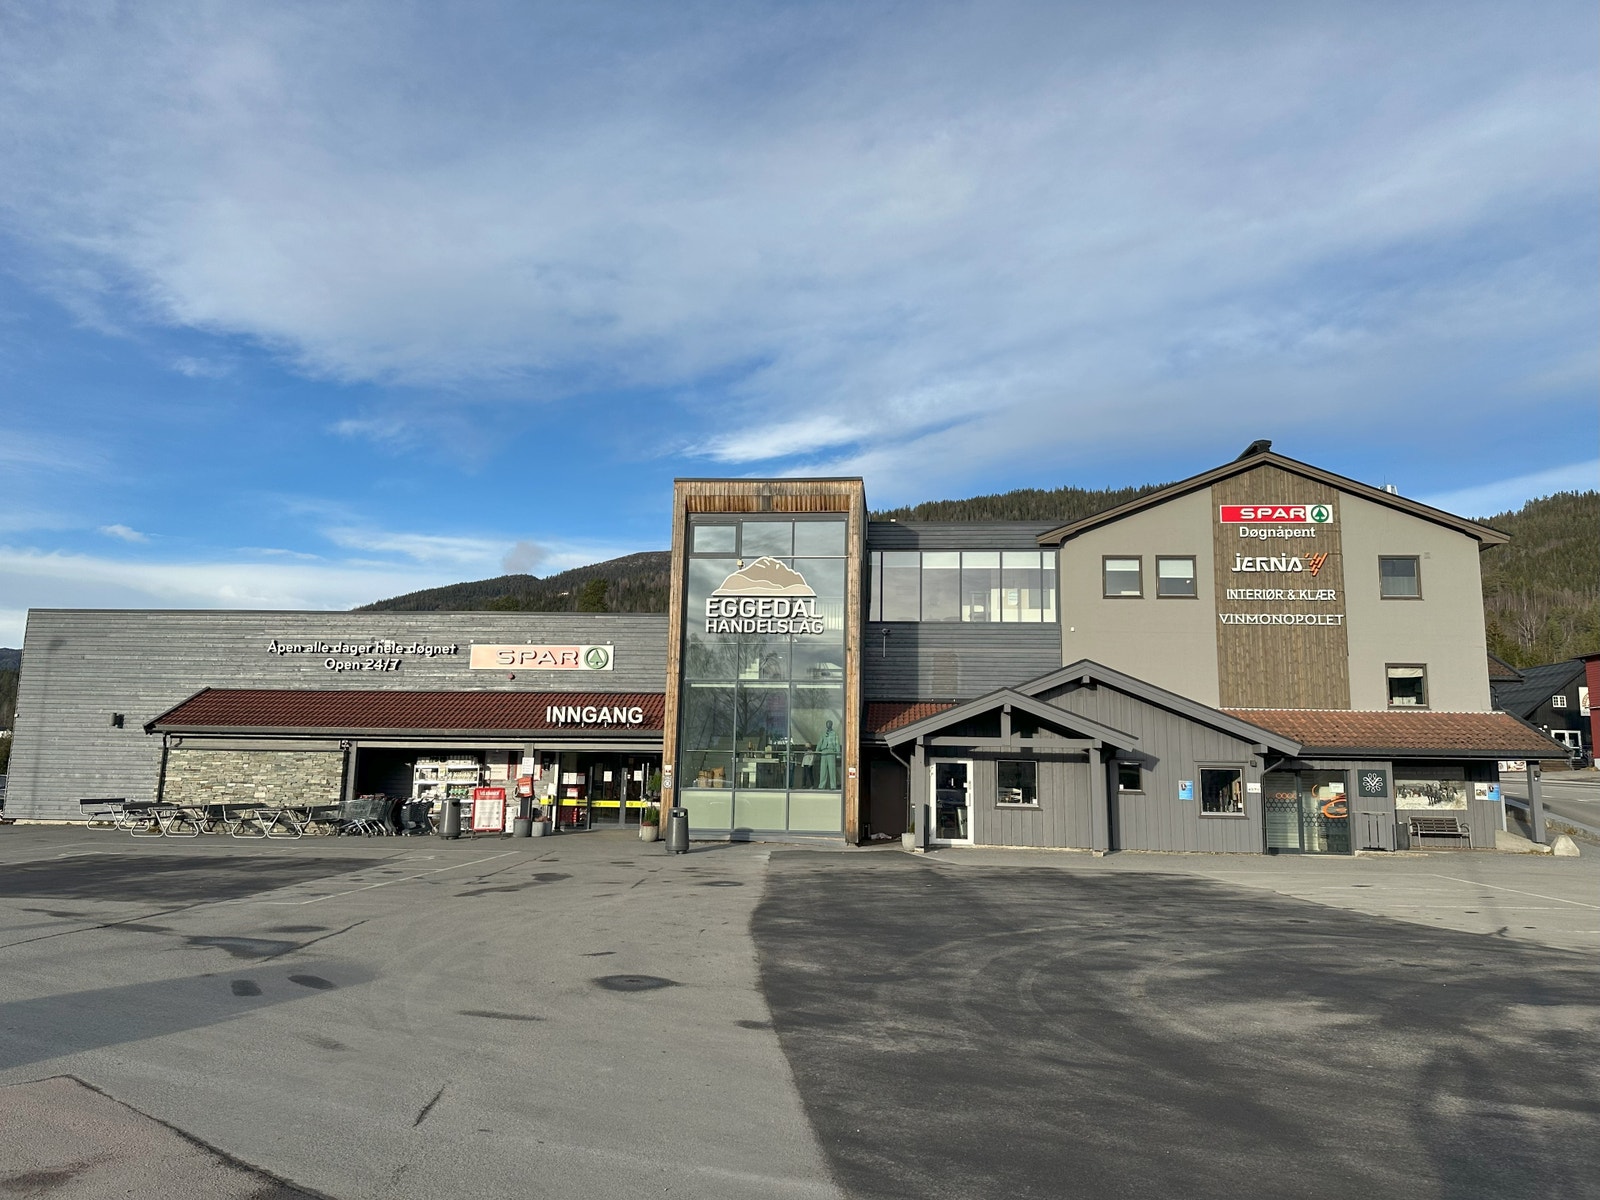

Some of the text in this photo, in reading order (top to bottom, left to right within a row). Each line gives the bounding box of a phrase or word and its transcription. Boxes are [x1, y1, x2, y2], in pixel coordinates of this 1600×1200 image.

[1240, 507, 1305, 519] SPAR
[1239, 526, 1315, 540] Døgnåpent
[1226, 589, 1337, 601] INTERIØR & KLÆR
[705, 598, 823, 618] EGGEDAL
[705, 619, 824, 633] HANDELSLAG
[1219, 613, 1344, 626] VINMONOPOLET
[306, 642, 331, 653] alle
[334, 641, 372, 655] dager
[375, 641, 403, 654] hele
[406, 642, 456, 655] døgnet
[324, 657, 399, 671] Open 24/7
[496, 650, 578, 665] SPAR
[546, 706, 644, 724] INNGANG
